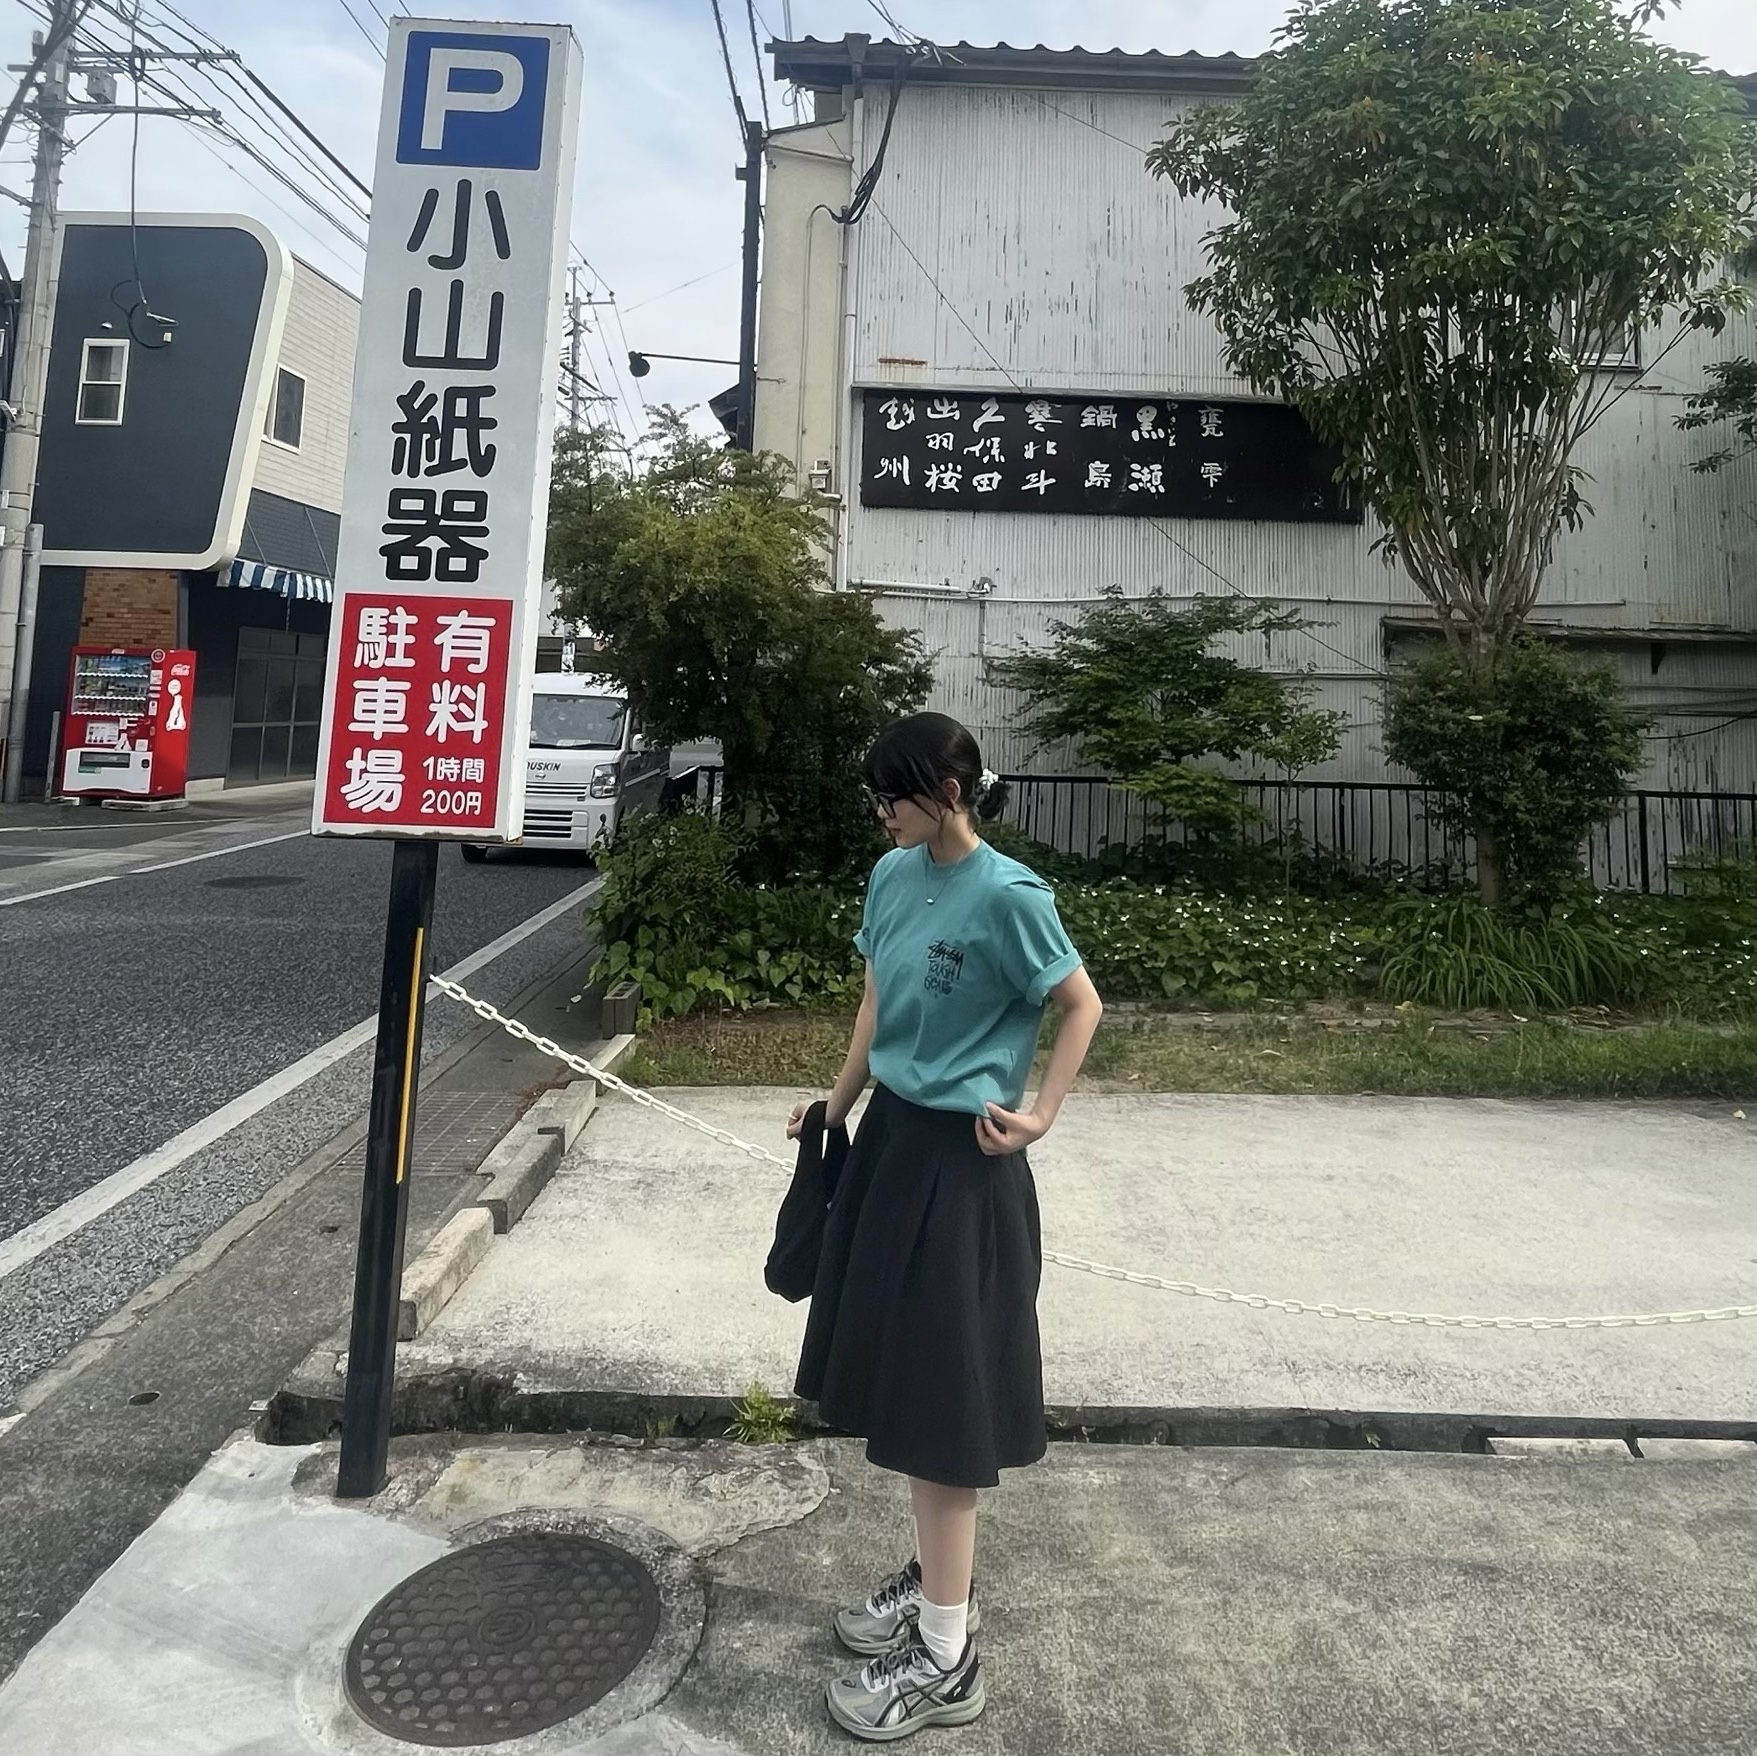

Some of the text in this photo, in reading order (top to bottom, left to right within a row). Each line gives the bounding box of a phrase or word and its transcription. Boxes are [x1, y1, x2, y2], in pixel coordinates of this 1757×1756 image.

[420, 47, 524, 151] P
[378, 178, 511, 583] 小山紙器
[924, 397, 963, 493] 出羽桜
[963, 397, 1006, 493] 久保田
[1128, 405, 1165, 493] 黒瀬
[339, 605, 419, 814] 駐車場
[425, 609, 497, 745] 有料
[420, 788, 482, 815] 200円
[422, 756, 485, 783] 1時間
